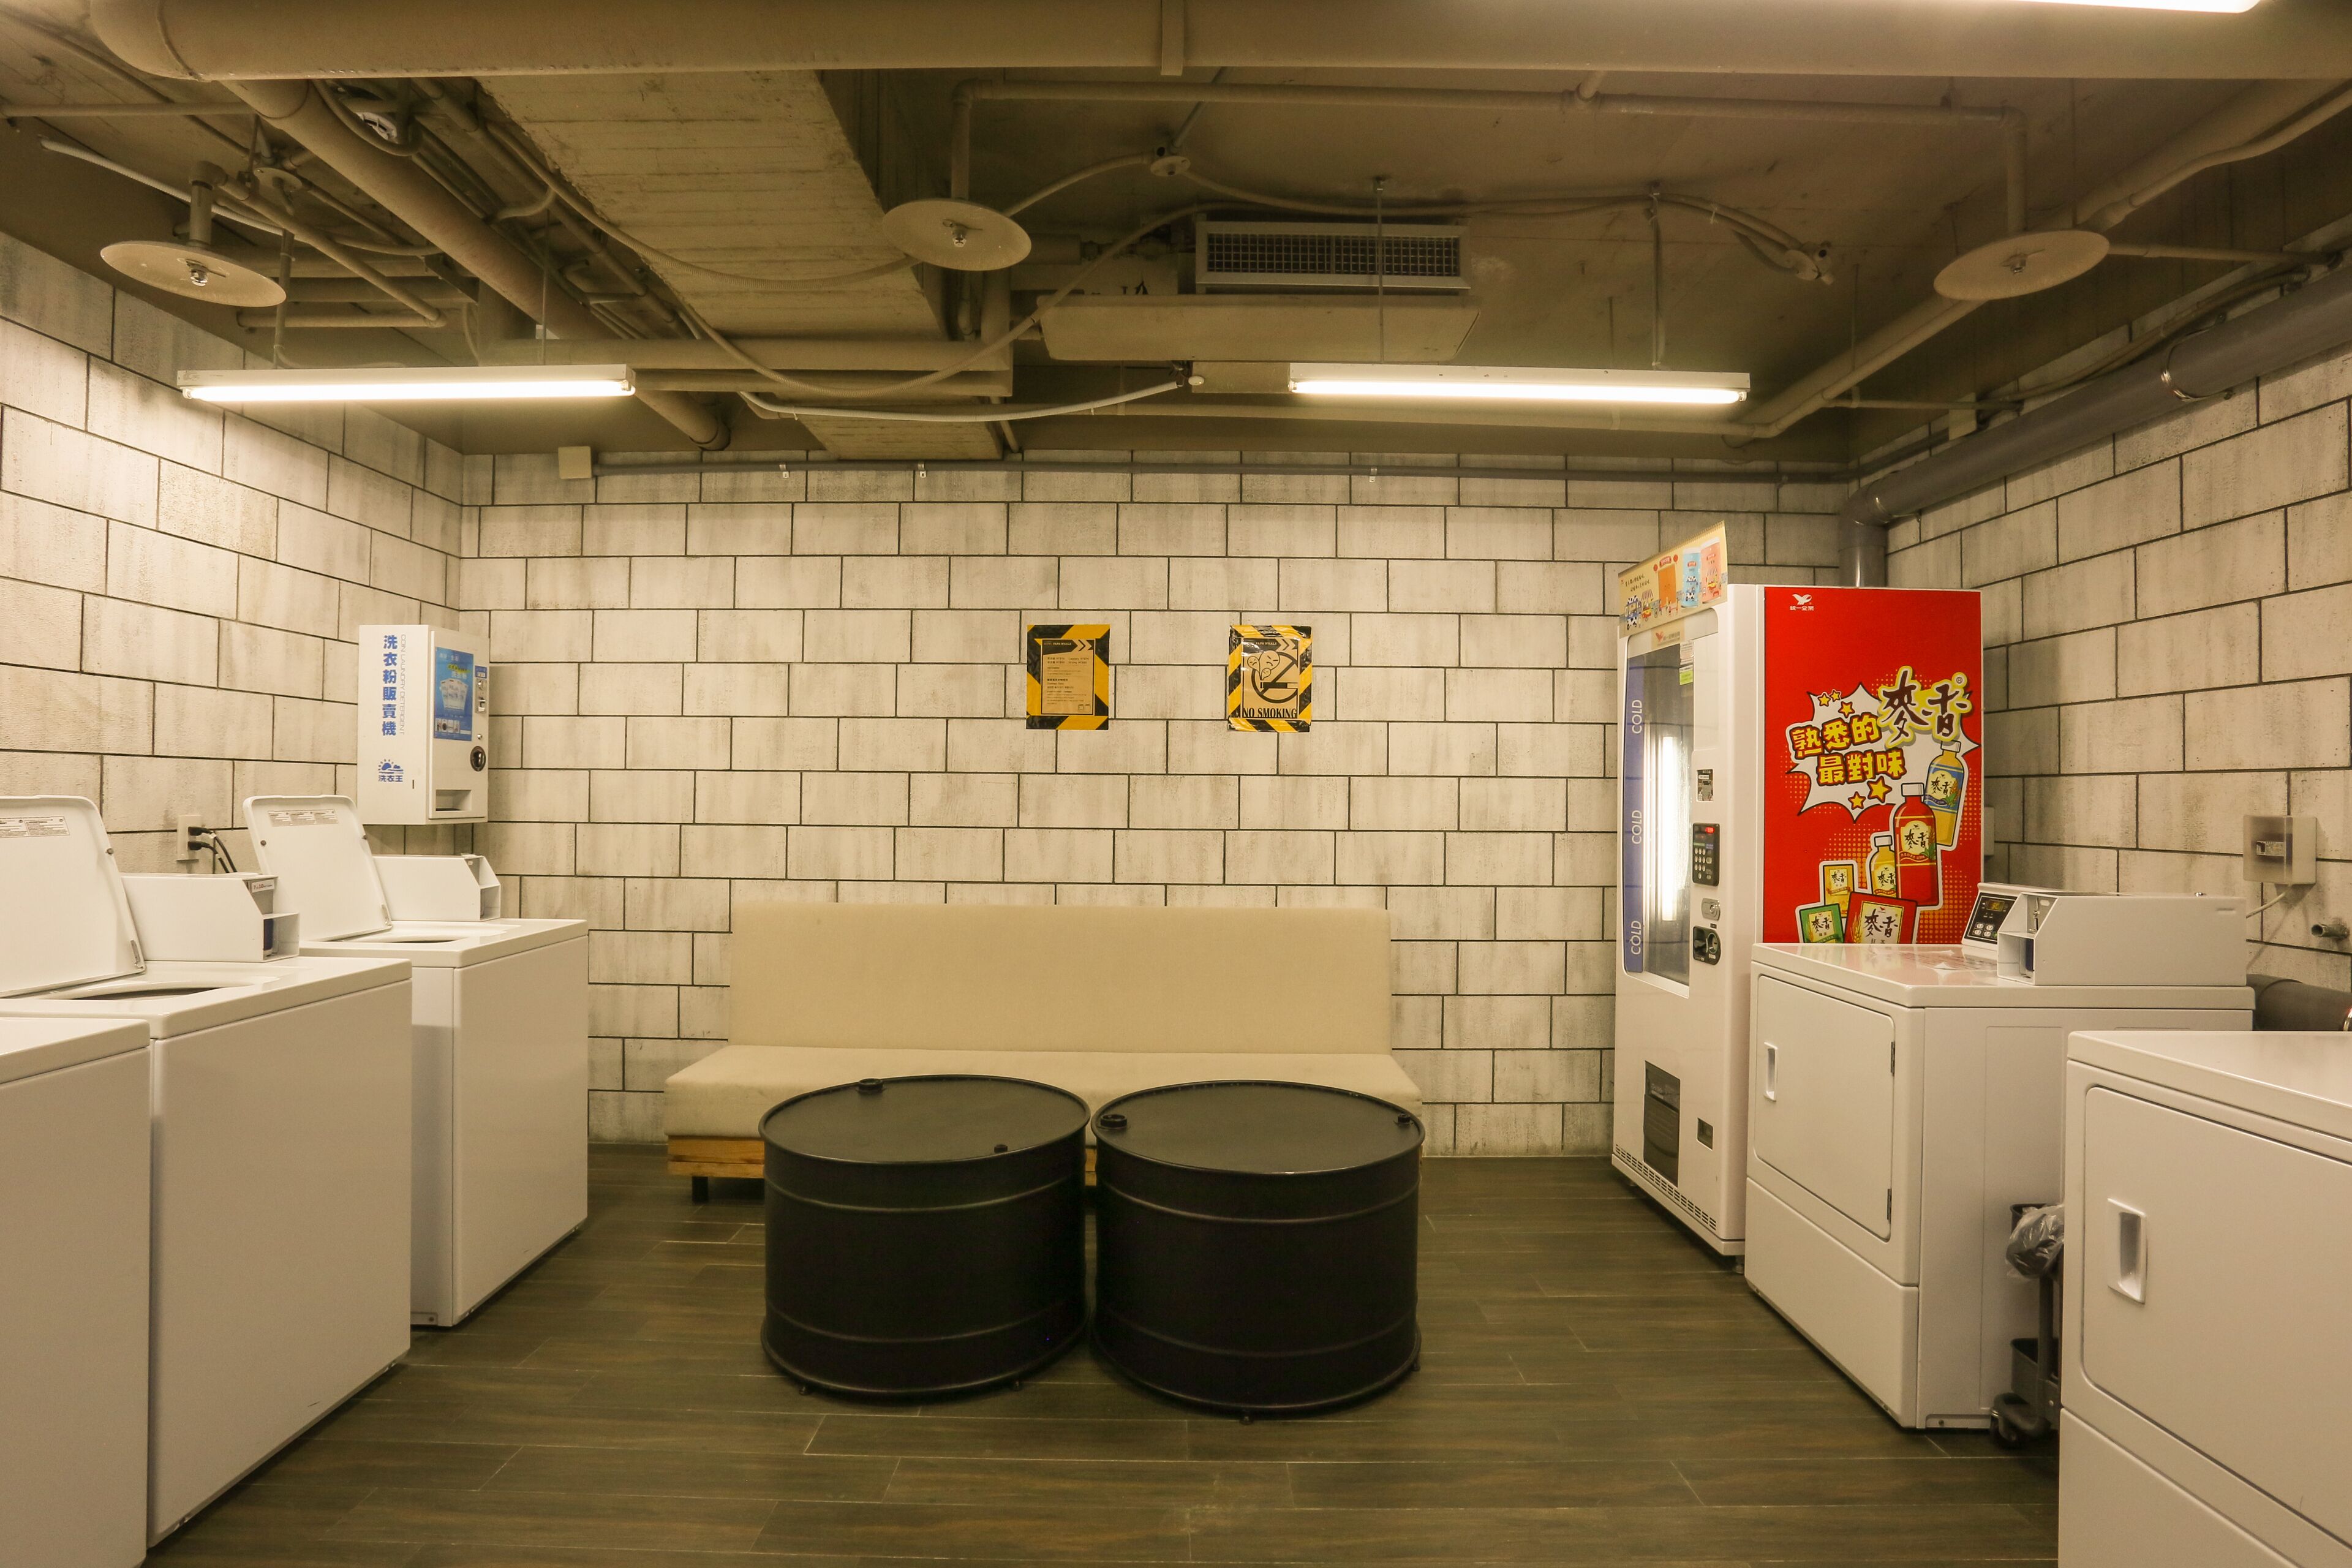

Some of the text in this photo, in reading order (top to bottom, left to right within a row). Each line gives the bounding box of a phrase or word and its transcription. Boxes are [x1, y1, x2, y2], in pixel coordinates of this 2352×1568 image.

[382, 635, 398, 736] 洗衣粉販賣機
[1243, 707, 1297, 718] NO SMOKING
[1632, 699, 1642, 734] COLD
[1792, 714, 1881, 758] 熟悉的
[1818, 749, 1906, 784] 最對味
[1632, 810, 1642, 845] COLD
[1630, 921, 1642, 955] COLD
